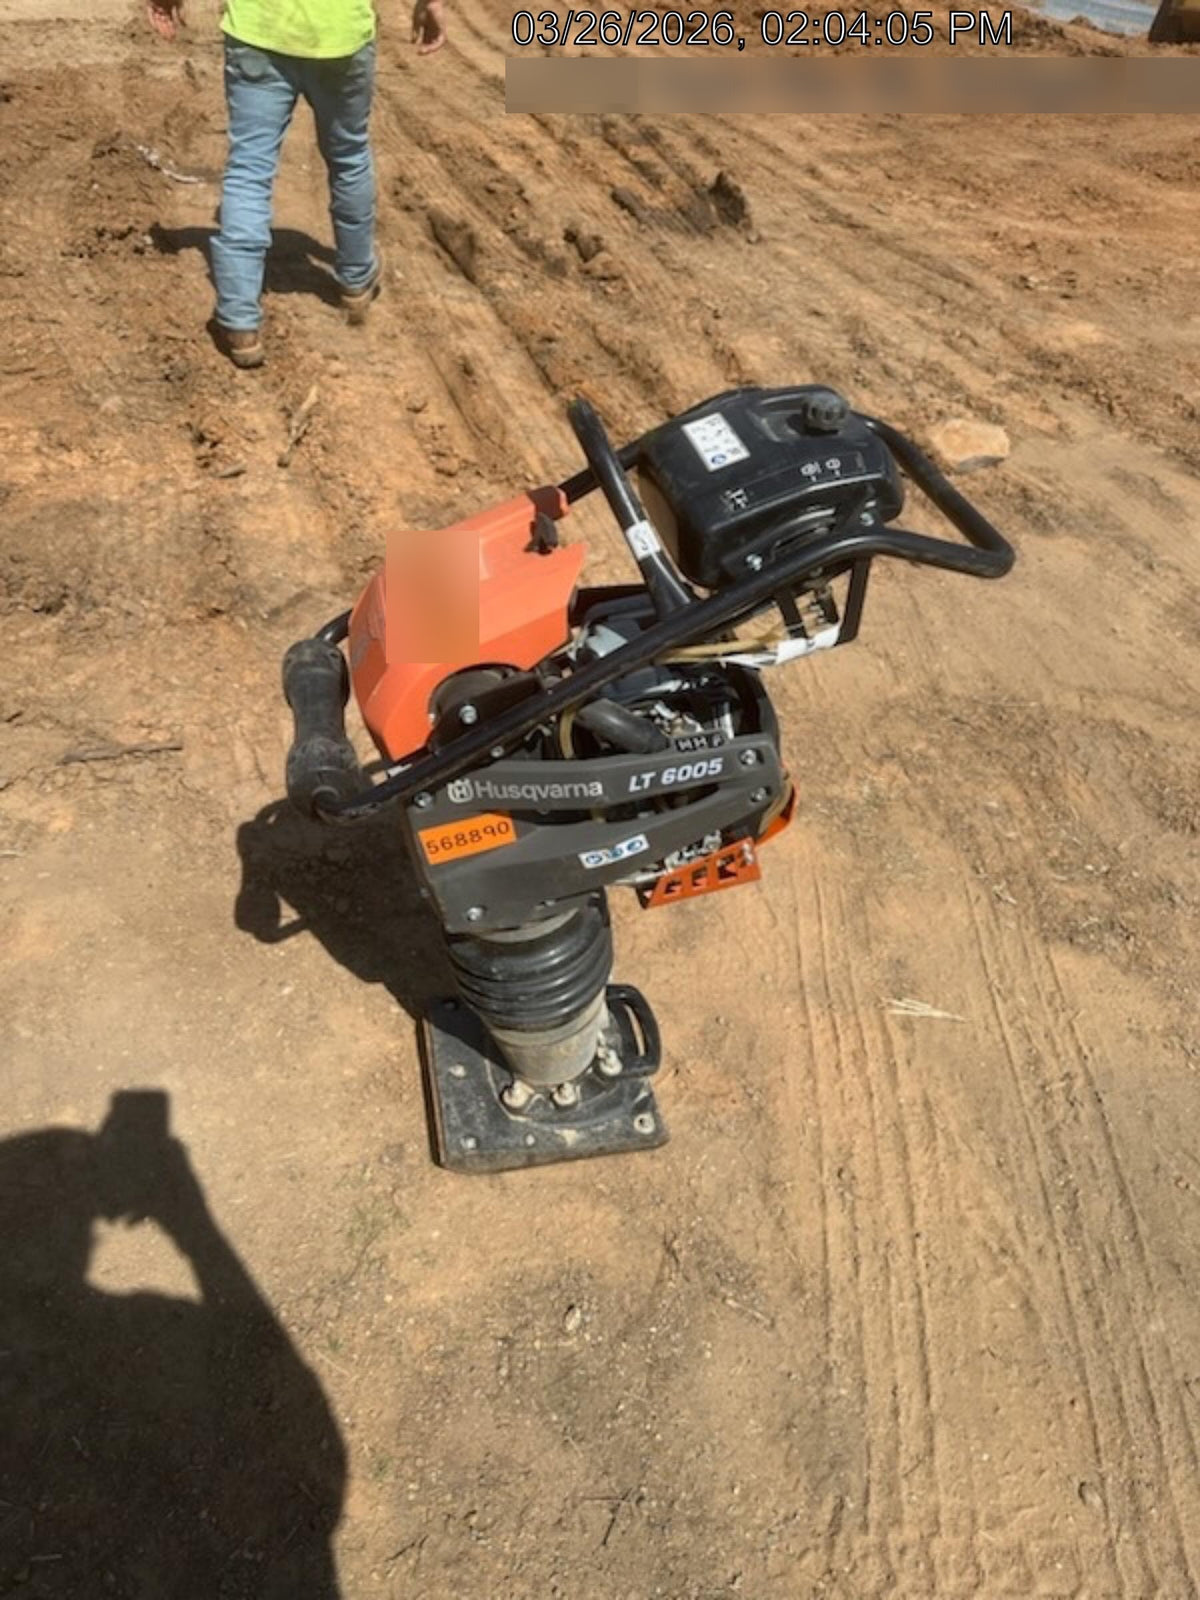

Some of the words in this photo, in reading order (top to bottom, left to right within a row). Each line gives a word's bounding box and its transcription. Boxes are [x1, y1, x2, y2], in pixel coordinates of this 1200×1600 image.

[474, 780, 603, 801] Husqvarna
[628, 772, 655, 793] LT
[661, 758, 723, 785] 6005
[426, 821, 509, 855] 568890
